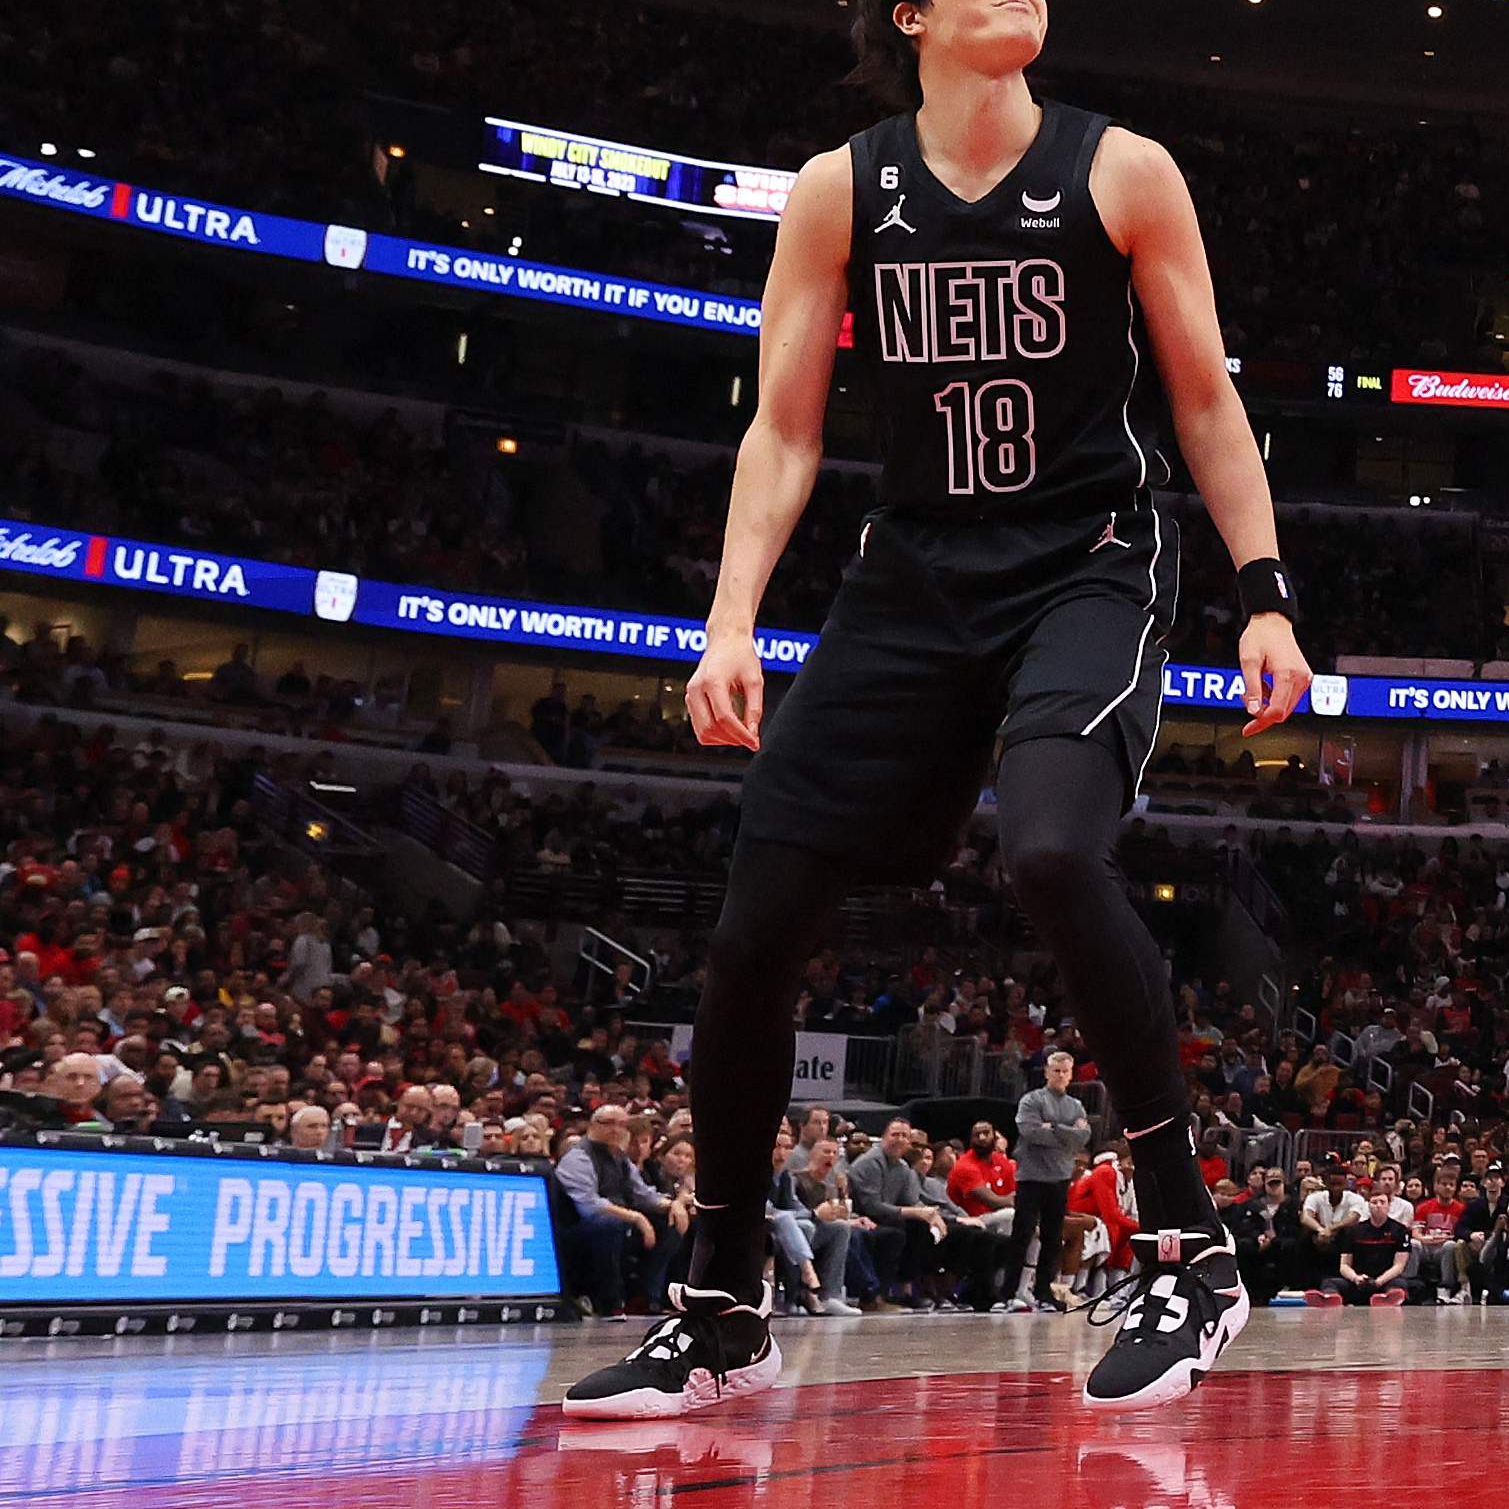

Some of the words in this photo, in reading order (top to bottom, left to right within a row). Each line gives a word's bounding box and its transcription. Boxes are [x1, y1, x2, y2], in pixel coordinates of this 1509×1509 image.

[567, 140, 599, 165] CITY
[880, 166, 899, 189] 6
[136, 192, 258, 245] ULTRA
[1020, 217, 1061, 229] Webull
[407, 248, 451, 275] IT'S
[453, 257, 515, 285] ONLY
[517, 267, 601, 301] WORTH
[603, 283, 626, 305] IT
[627, 287, 650, 308] IF
[653, 291, 700, 318] YOU
[702, 299, 761, 328] ENJO
[874, 259, 1066, 363] NETS
[1327, 382, 1343, 399] 76
[1357, 375, 1382, 390] FINAL
[934, 379, 1036, 495] 18
[114, 546, 250, 597] ULTRA
[398, 595, 445, 623] IT'S
[447, 602, 517, 631] ONLY
[520, 610, 615, 642] WORTH
[618, 621, 644, 644] IT
[645, 624, 671, 647] IF
[1165, 670, 1245, 700] LTRA
[1389, 686, 1429, 709] IT'S
[1432, 689, 1492, 710] ONLY
[209, 1176, 535, 1277] PROGRESSIVE
